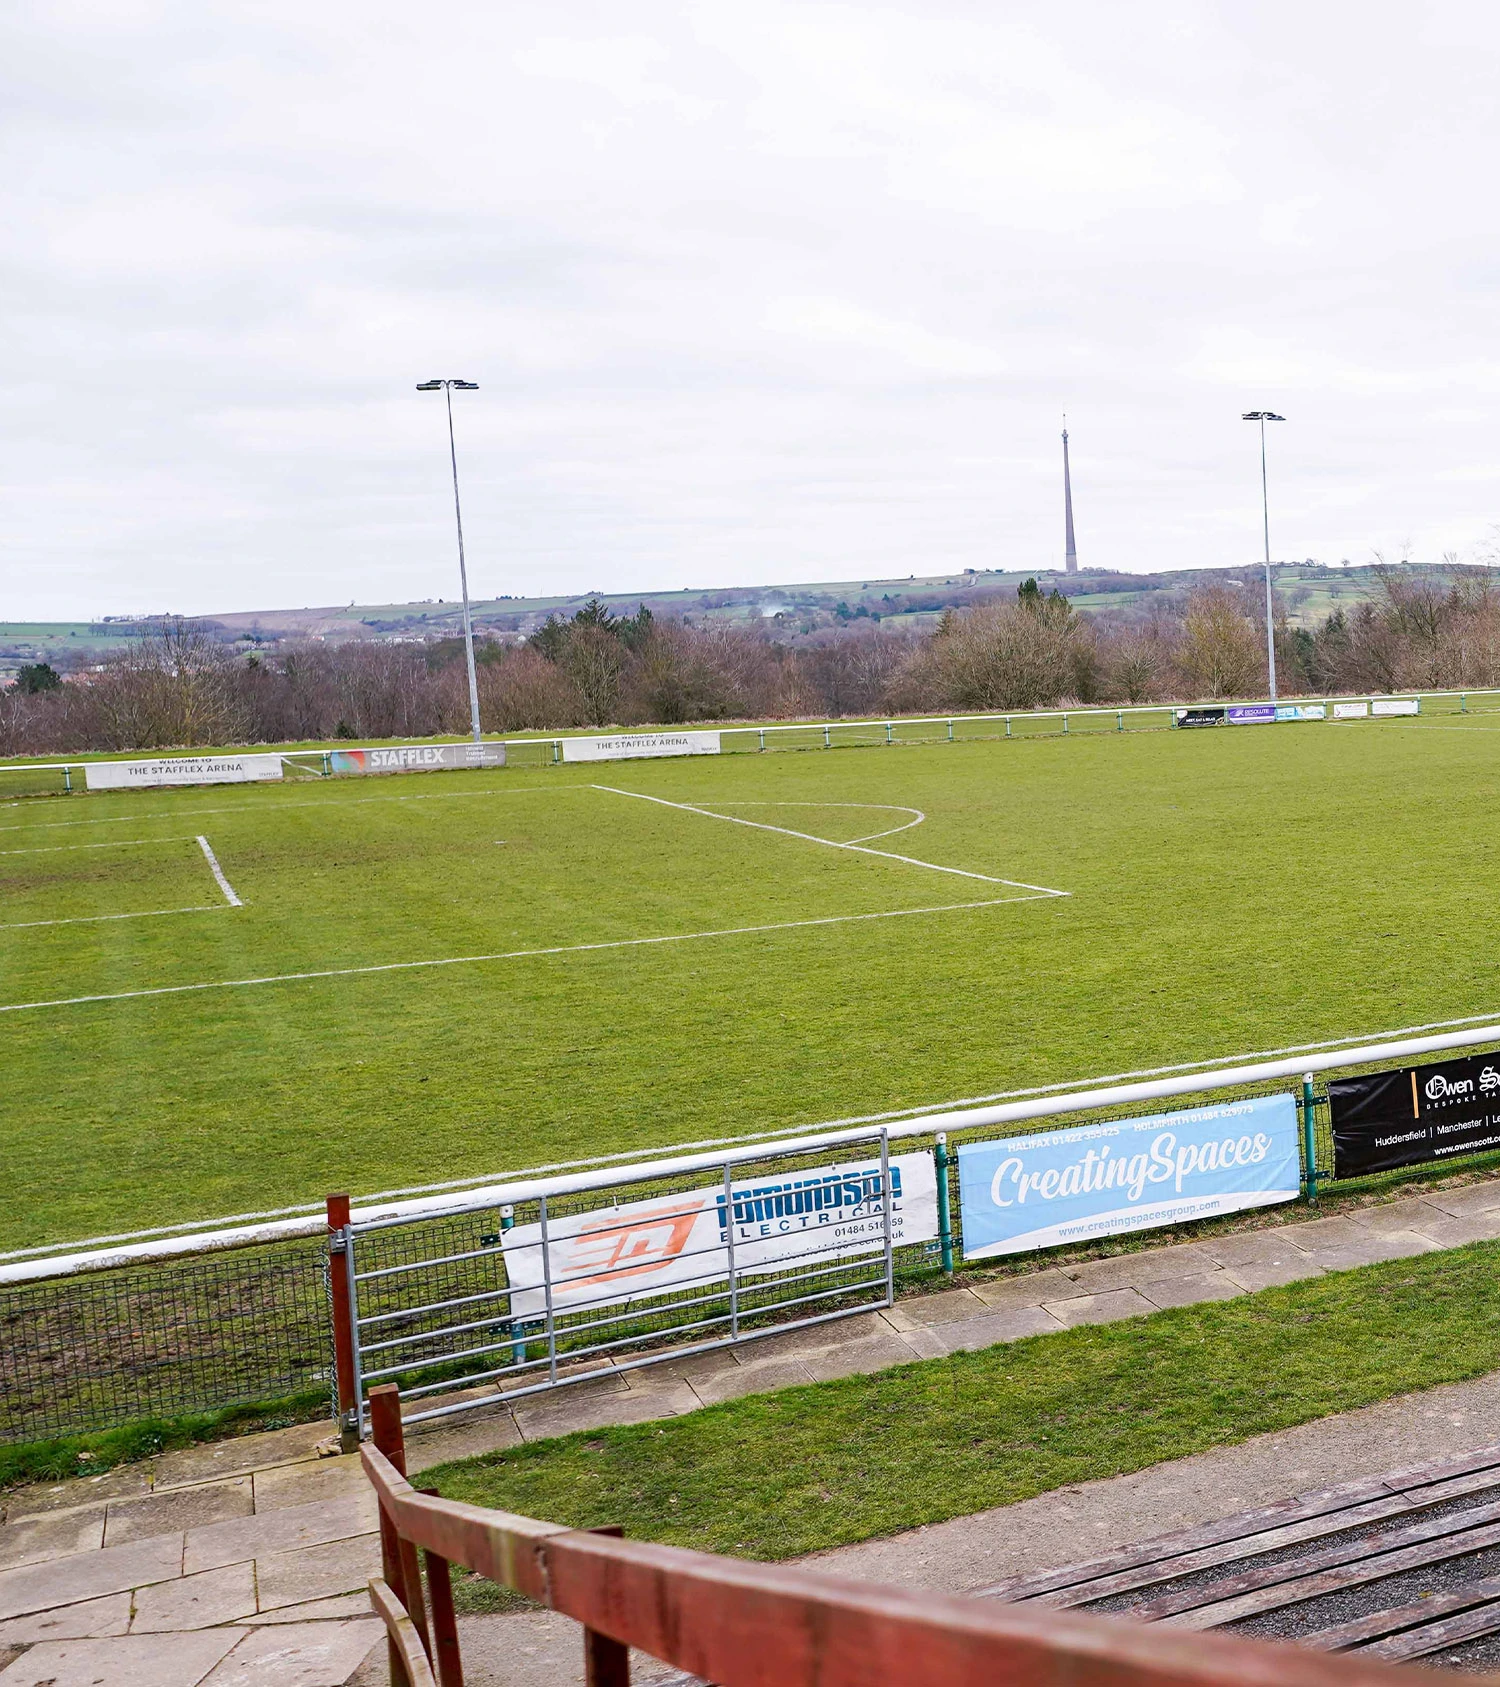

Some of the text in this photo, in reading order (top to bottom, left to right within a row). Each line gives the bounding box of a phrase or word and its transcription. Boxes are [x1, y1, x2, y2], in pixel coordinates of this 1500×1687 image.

[596, 738, 689, 750] THE STAFFLEX ARENA
[371, 748, 447, 767] STAFFLEX
[128, 763, 243, 776] THE STAFFLEX ARENA
[1425, 1074, 1474, 1100] Owen
[1426, 1094, 1477, 1110] BESPOKE
[1133, 1115, 1190, 1132] HOLMFIRTH
[1191, 1111, 1219, 1125] 01484
[1008, 1137, 1050, 1153] HALIFAX
[1052, 1133, 1083, 1147] 01422
[1375, 1127, 1427, 1148] Huddersfield
[1437, 1118, 1482, 1136] Manchester
[719, 1202, 903, 1243] ELECTRICAL
[834, 1217, 904, 1238] 01484 51659
[1058, 1199, 1221, 1237] www.creatingspacesgroup.com
